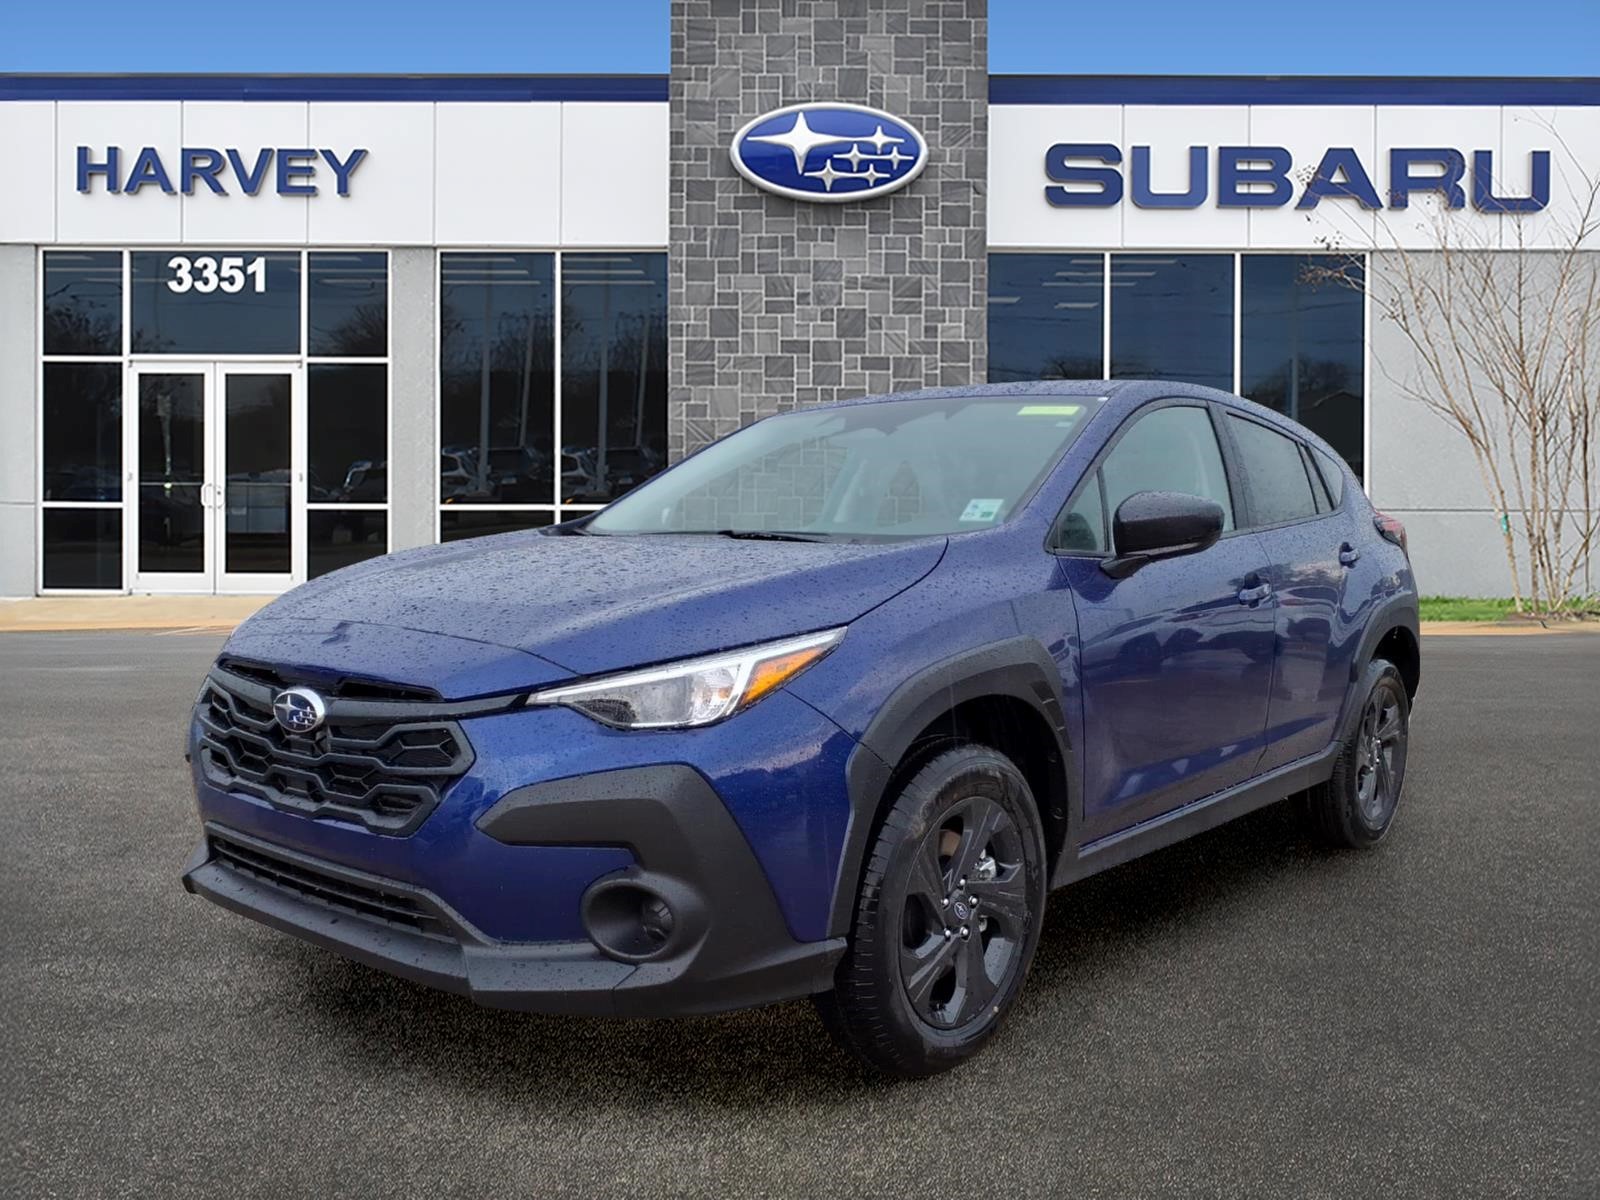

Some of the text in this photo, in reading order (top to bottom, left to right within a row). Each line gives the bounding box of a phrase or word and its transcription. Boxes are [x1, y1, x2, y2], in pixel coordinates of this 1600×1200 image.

[77, 146, 367, 197] HARVEY
[1045, 143, 1551, 212] SUBARU
[167, 256, 266, 293] 3351
